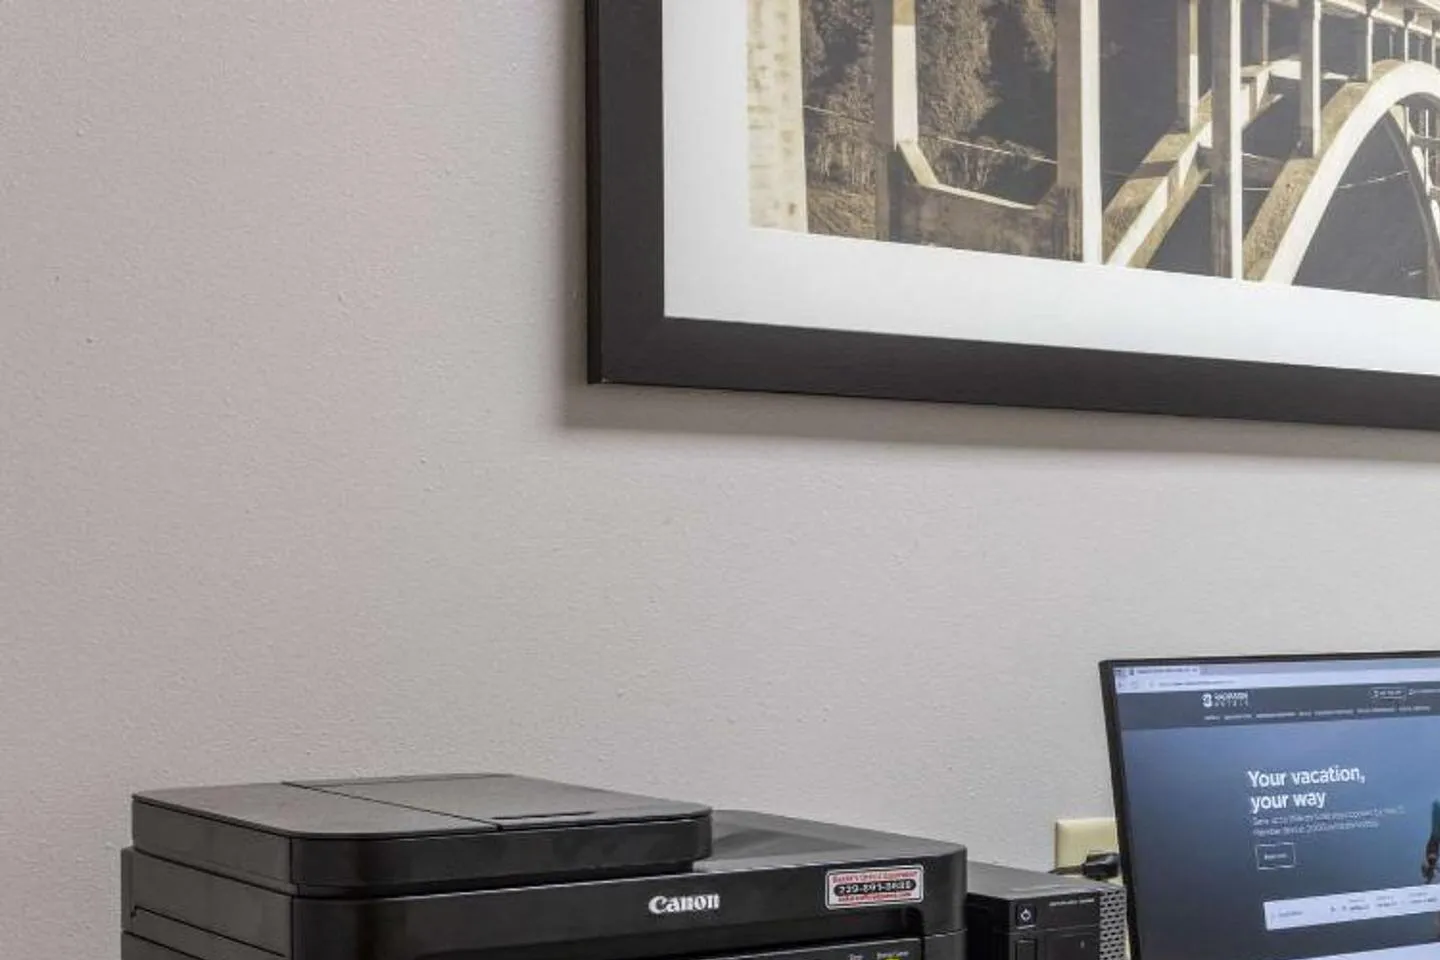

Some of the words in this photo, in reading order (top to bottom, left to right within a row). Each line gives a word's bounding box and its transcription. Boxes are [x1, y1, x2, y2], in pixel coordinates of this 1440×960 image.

[1248, 770, 1287, 788] Your
[1290, 765, 1366, 785] vacation,
[1250, 794, 1289, 814] your
[1293, 792, 1326, 809] way
[648, 893, 720, 915] Canon
